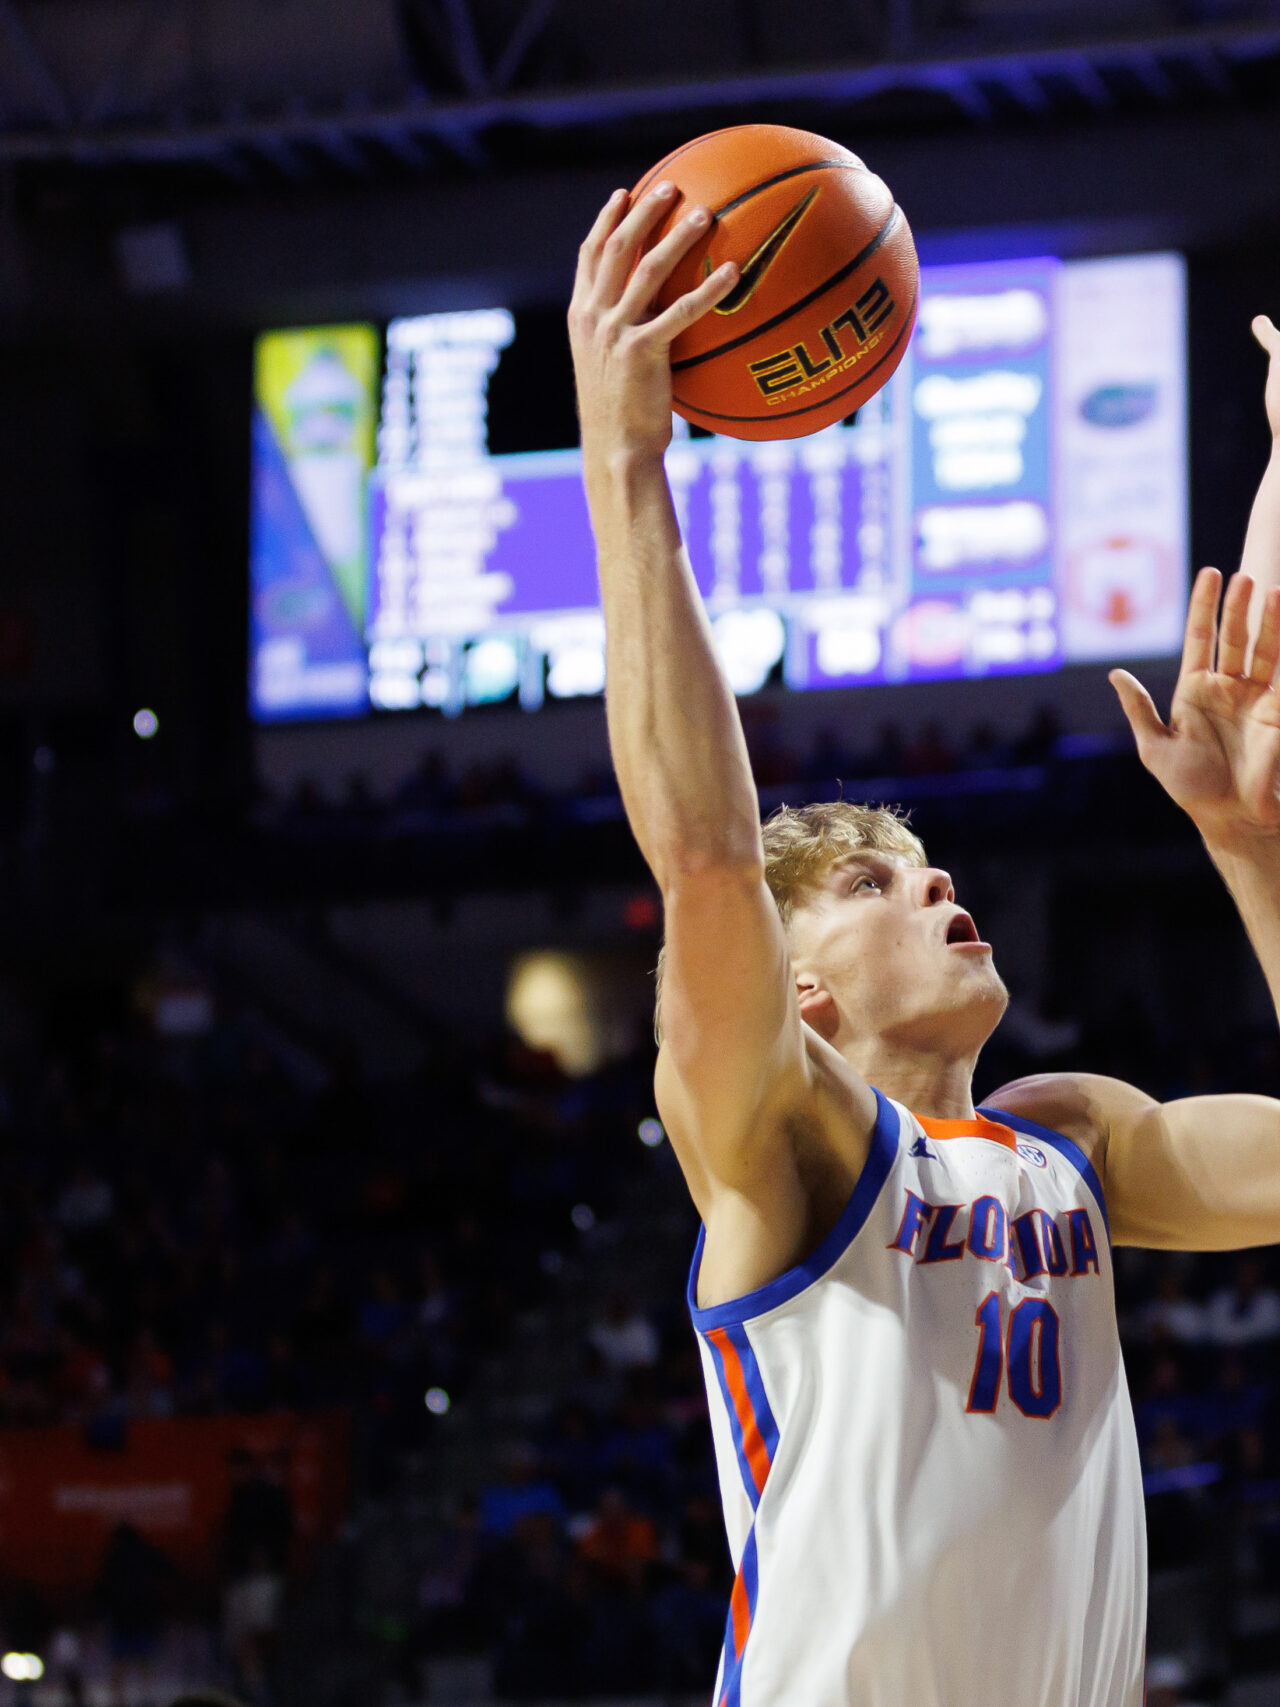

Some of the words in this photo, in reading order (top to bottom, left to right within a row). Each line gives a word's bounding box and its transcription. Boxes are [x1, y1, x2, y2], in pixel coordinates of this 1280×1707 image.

[747, 276, 896, 396] ELITE
[766, 320, 890, 406] CHAMPIONS
[965, 1290, 1063, 1420] 10
